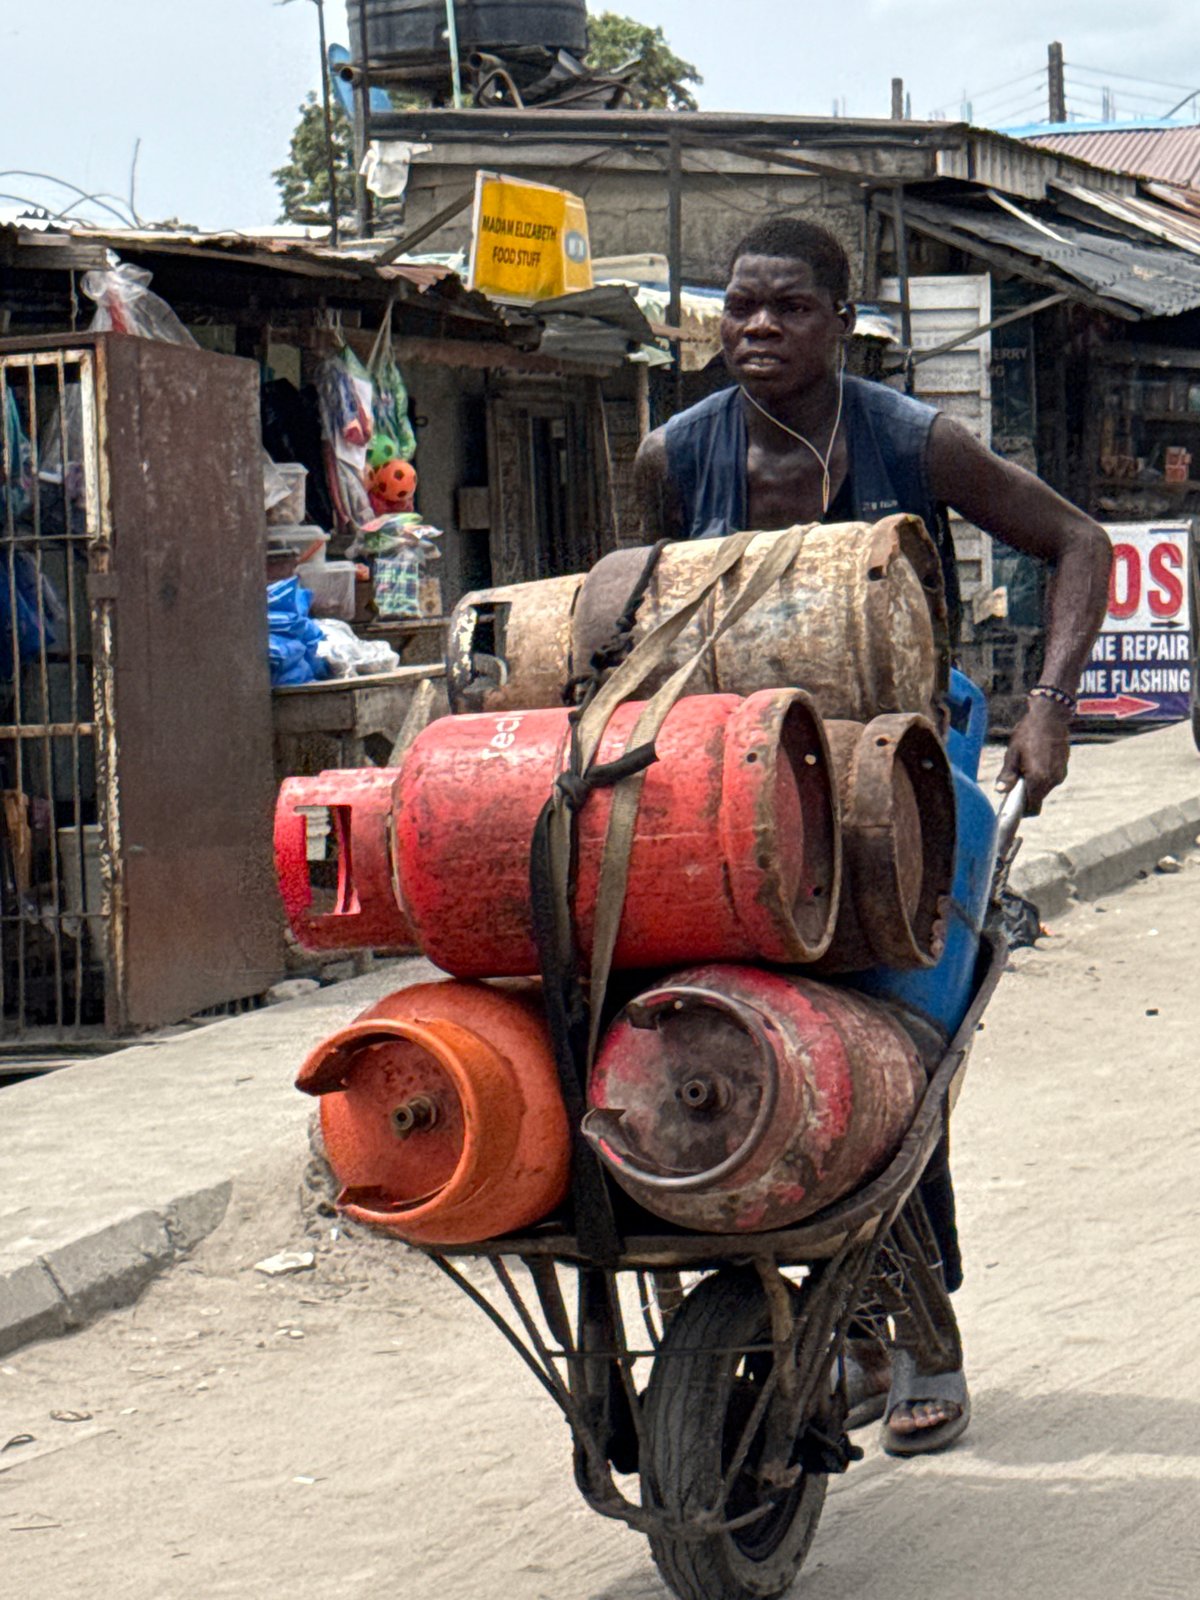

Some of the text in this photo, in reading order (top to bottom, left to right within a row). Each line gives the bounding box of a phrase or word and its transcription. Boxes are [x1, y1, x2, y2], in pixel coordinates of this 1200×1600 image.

[482, 216, 557, 241] MADAM ELIZABETH
[493, 246, 541, 267] FOOD STUFF
[1122, 635, 1189, 661] REPAIR
[1111, 668, 1191, 693] FLASHING
